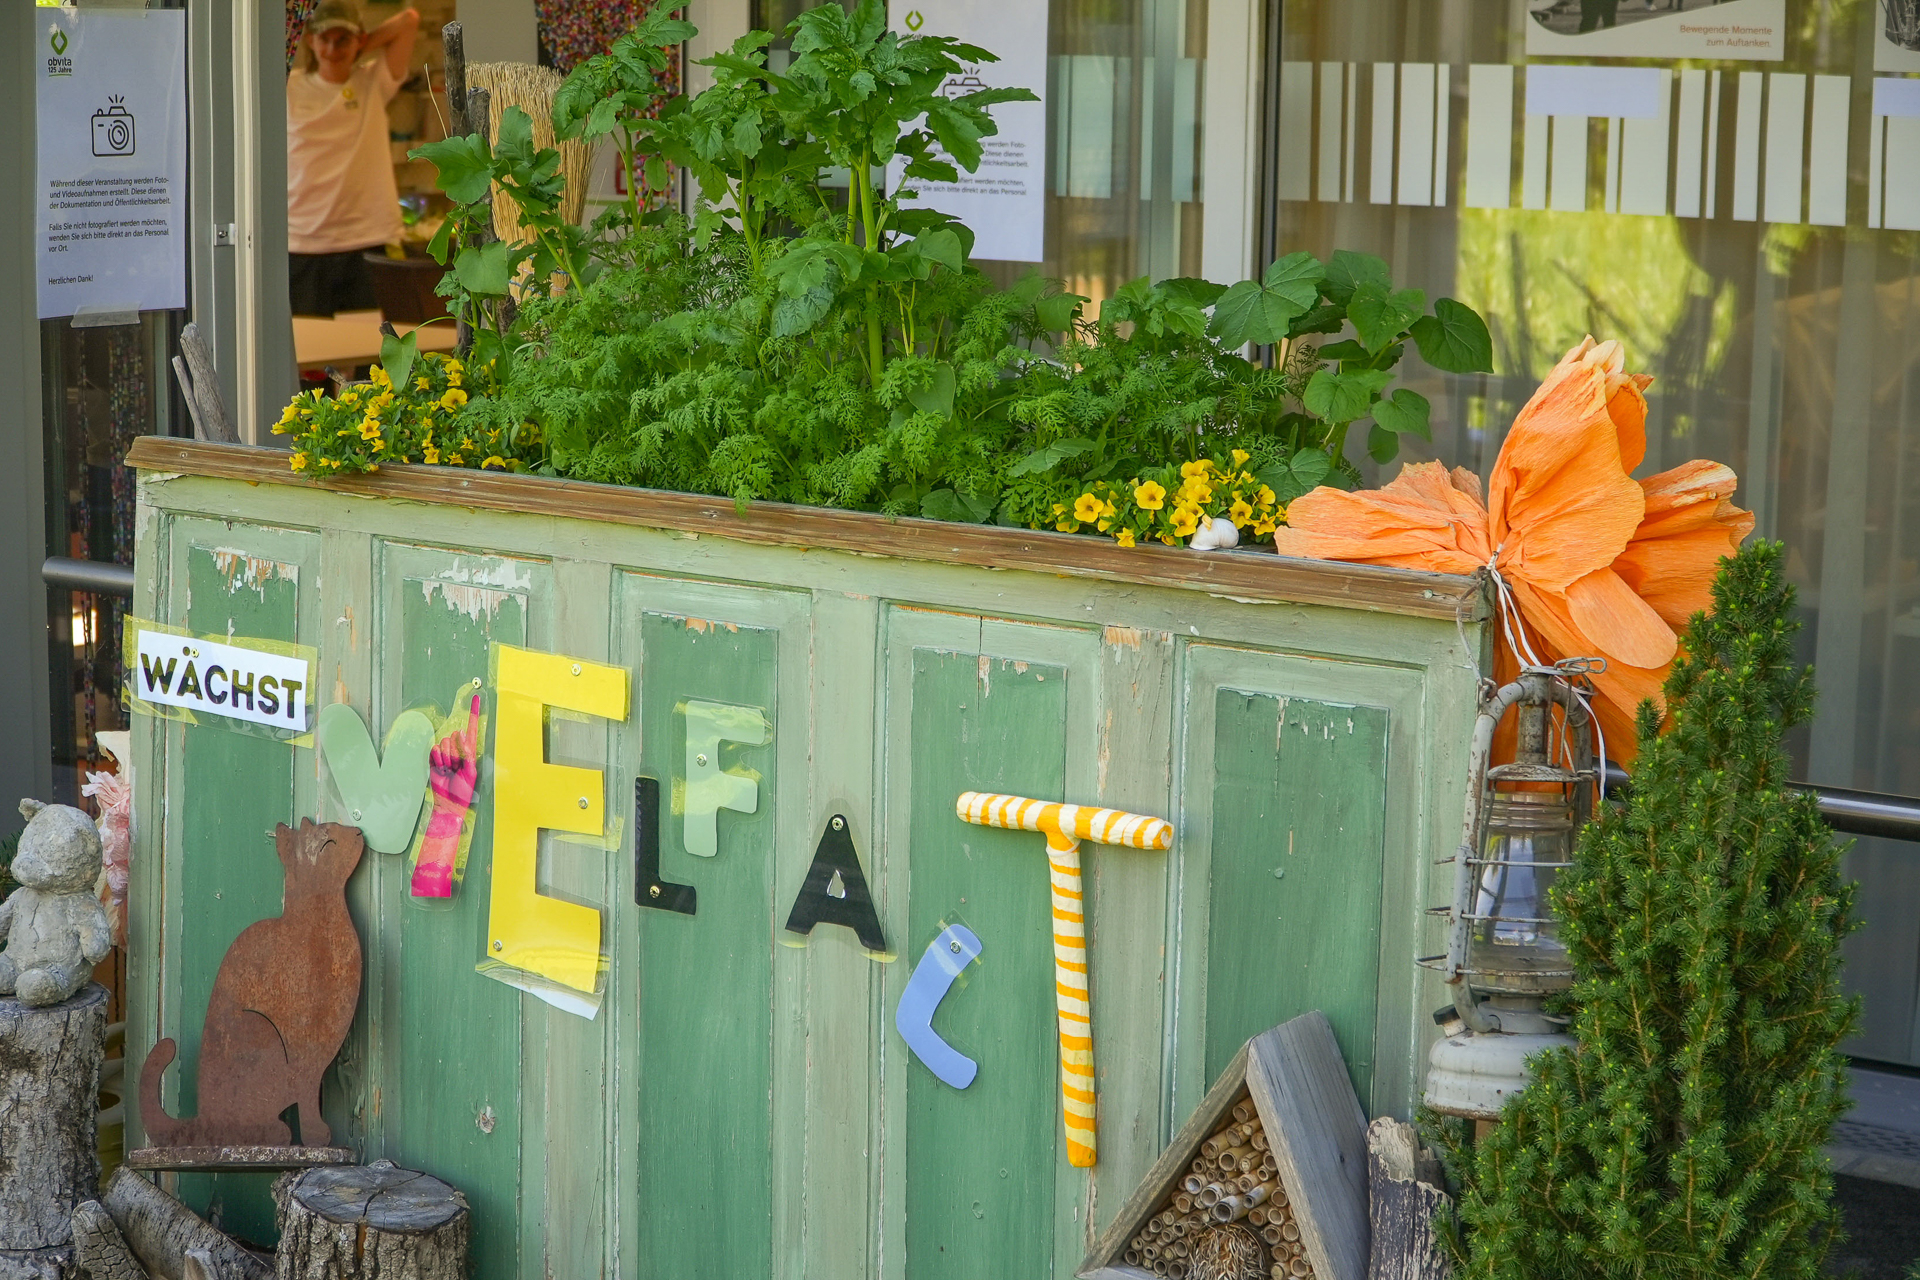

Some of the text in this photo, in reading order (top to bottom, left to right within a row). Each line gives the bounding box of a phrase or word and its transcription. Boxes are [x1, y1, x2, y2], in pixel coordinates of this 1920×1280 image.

[1680, 25, 1773, 35] Bewegende Momente
[48, 57, 72, 66] obvita
[50, 180, 76, 188] Während
[77, 178, 94, 187] dieser
[95, 177, 132, 187] Veranstaltung
[50, 190, 60, 198] und
[62, 189, 108, 198] Videoaufnahmen
[60, 200, 101, 209] Dokumentation
[49, 223, 62, 231] Falls
[63, 222, 72, 230] Sie
[88, 220, 118, 230] fotografiert
[48, 234, 70, 242] wenden
[81, 232, 92, 240] sich
[94, 231, 106, 239] bitte
[107, 230, 123, 238] direkt
[144, 228, 169, 236] Personal
[48, 276, 76, 285] Herzlichen
[140, 647, 303, 720] WÄCHST
